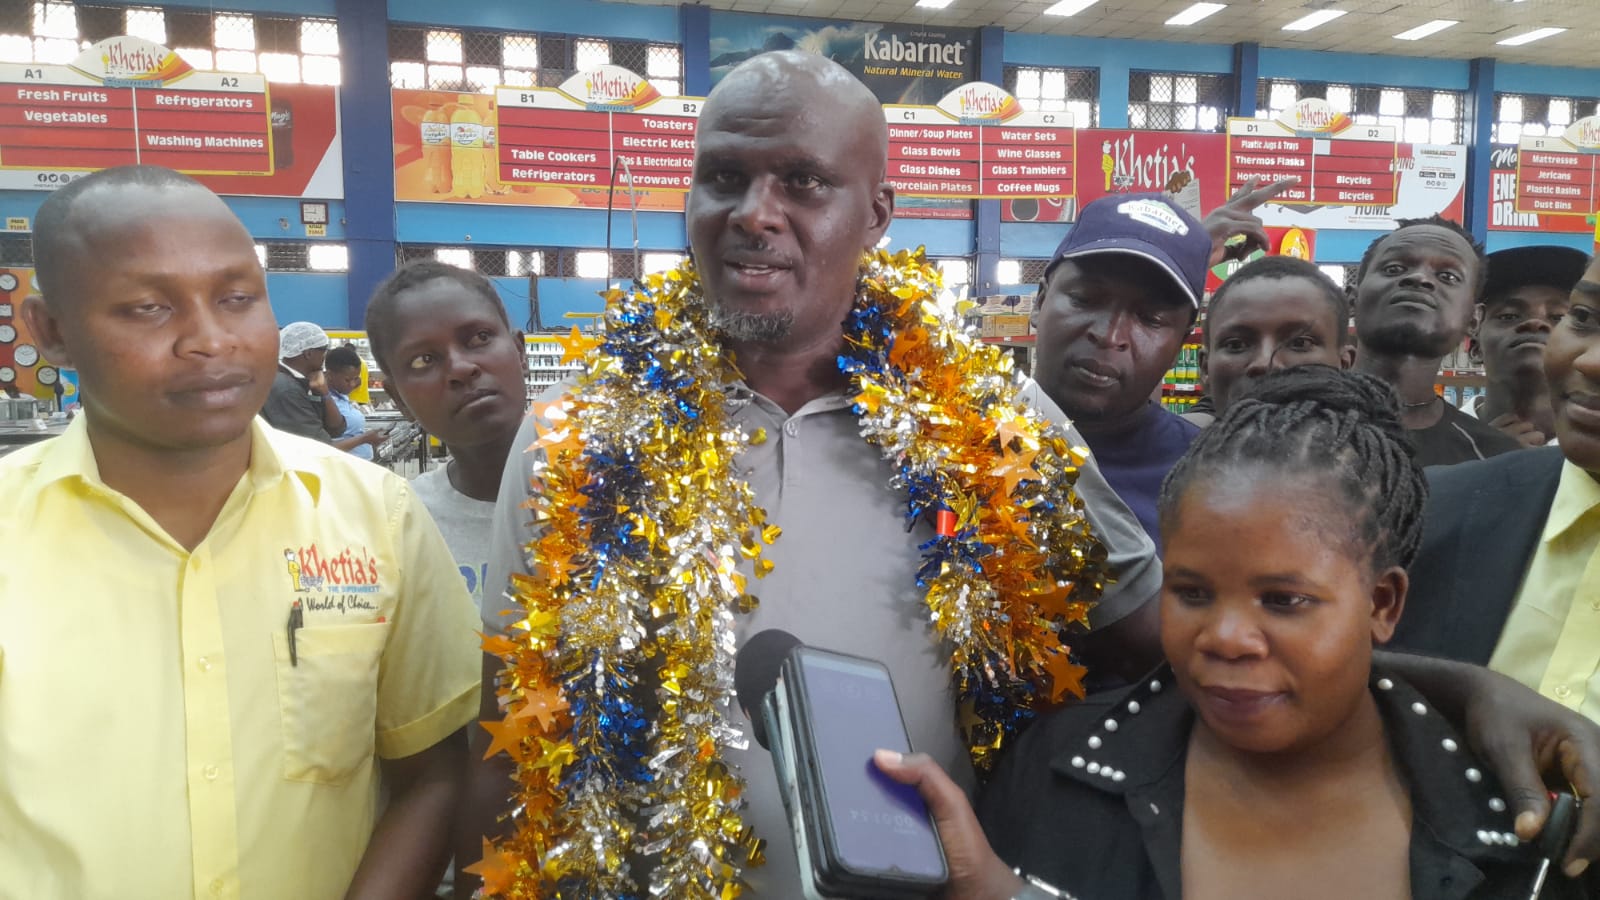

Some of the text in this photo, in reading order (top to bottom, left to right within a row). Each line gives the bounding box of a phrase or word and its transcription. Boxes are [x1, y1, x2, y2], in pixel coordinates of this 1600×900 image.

[864, 32, 966, 66] Kabarnet
[108, 41, 163, 72] Khetia's
[25, 69, 42, 79] A1
[863, 65, 963, 79] Natural Mineral Water
[221, 77, 239, 87] A2
[592, 70, 637, 98] Khetia's
[17, 89, 108, 103] Fresh Fruits
[155, 95, 254, 108] Refrigerators
[520, 93, 535, 103] B1
[965, 88, 1003, 112] Khetia's
[683, 103, 697, 113] B2
[24, 110, 108, 123] Vegetables
[903, 111, 916, 120] C1
[1043, 115, 1055, 123] C2
[642, 118, 694, 131] Toasters
[889, 128, 973, 139] Dinner/Soup Plates
[1001, 131, 1057, 141] Water Sets
[1368, 130, 1379, 138] D2
[147, 135, 264, 148] Washing Machines
[623, 137, 696, 150] Electric Kett
[1241, 140, 1262, 149] Plastic
[511, 149, 597, 162] Table Cookers
[902, 146, 961, 157] Glass Bowls
[997, 149, 1061, 159] Wine Glasses
[636, 156, 642, 166] &
[643, 156, 682, 168] Electrical
[1114, 133, 1195, 189] Khetia's
[1235, 155, 1305, 167] Thermos Flasks
[1532, 154, 1578, 165] Mattresses
[512, 168, 596, 182] Refrigerators
[900, 164, 961, 176] Glass Dishes
[992, 166, 1018, 175] Glass
[1538, 170, 1571, 181] Jericans
[619, 173, 680, 185] Mcrowave
[1336, 175, 1372, 185] Bicycles
[889, 180, 973, 192] Porcelain Plates
[997, 183, 1060, 194] Coffee Mugs
[1493, 173, 1516, 202] ENE
[1526, 185, 1580, 195] Plastic Basins
[1289, 190, 1305, 199] Cups
[1339, 192, 1374, 202] Bicycles
[1534, 200, 1571, 210] Dust Bins
[298, 543, 378, 584] Khetia's
[306, 595, 334, 611] World
[337, 595, 345, 614] of
